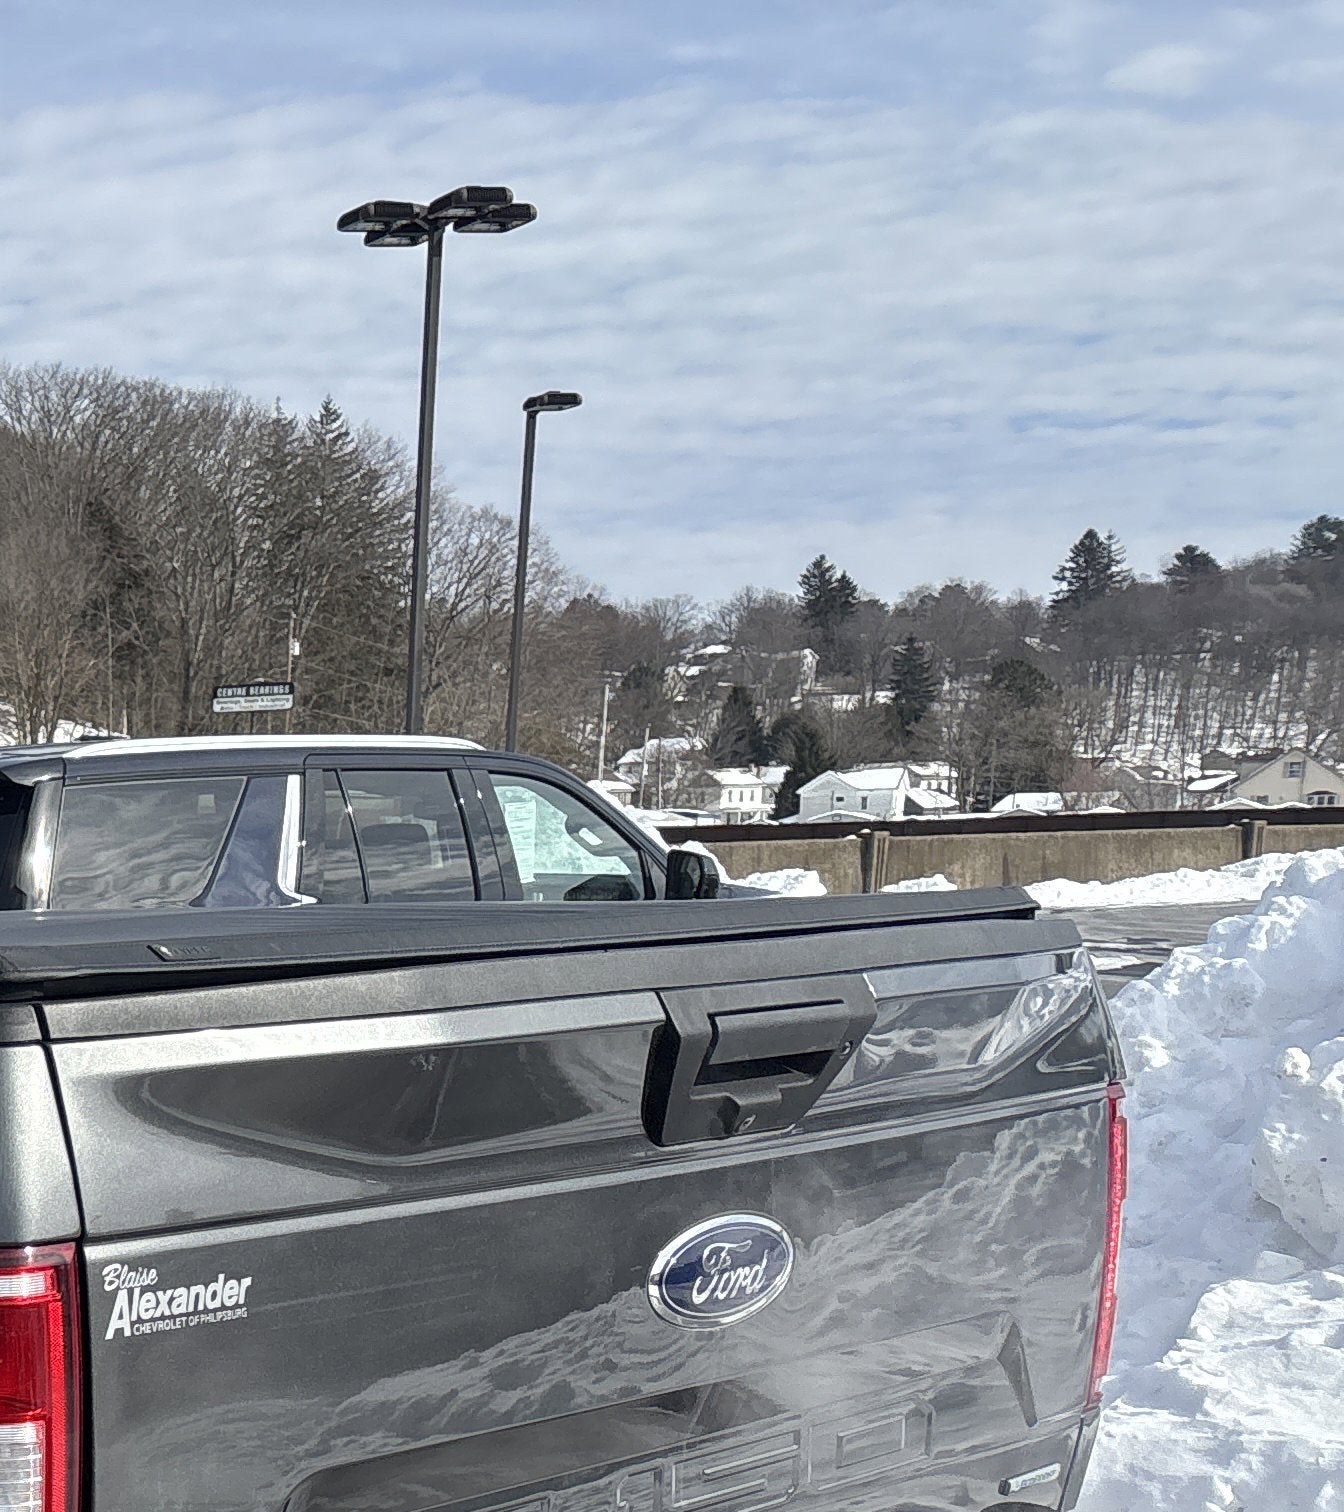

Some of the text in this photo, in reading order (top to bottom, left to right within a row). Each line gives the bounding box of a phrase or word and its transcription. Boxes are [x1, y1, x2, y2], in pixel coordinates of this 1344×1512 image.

[249, 685, 290, 695] BEARINGS
[102, 1263, 158, 1291] Blaise
[692, 1239, 769, 1304] Ford
[105, 1273, 252, 1340] Alexander
[133, 1316, 187, 1336] CHEVROLET
[188, 1313, 200, 1327] OF
